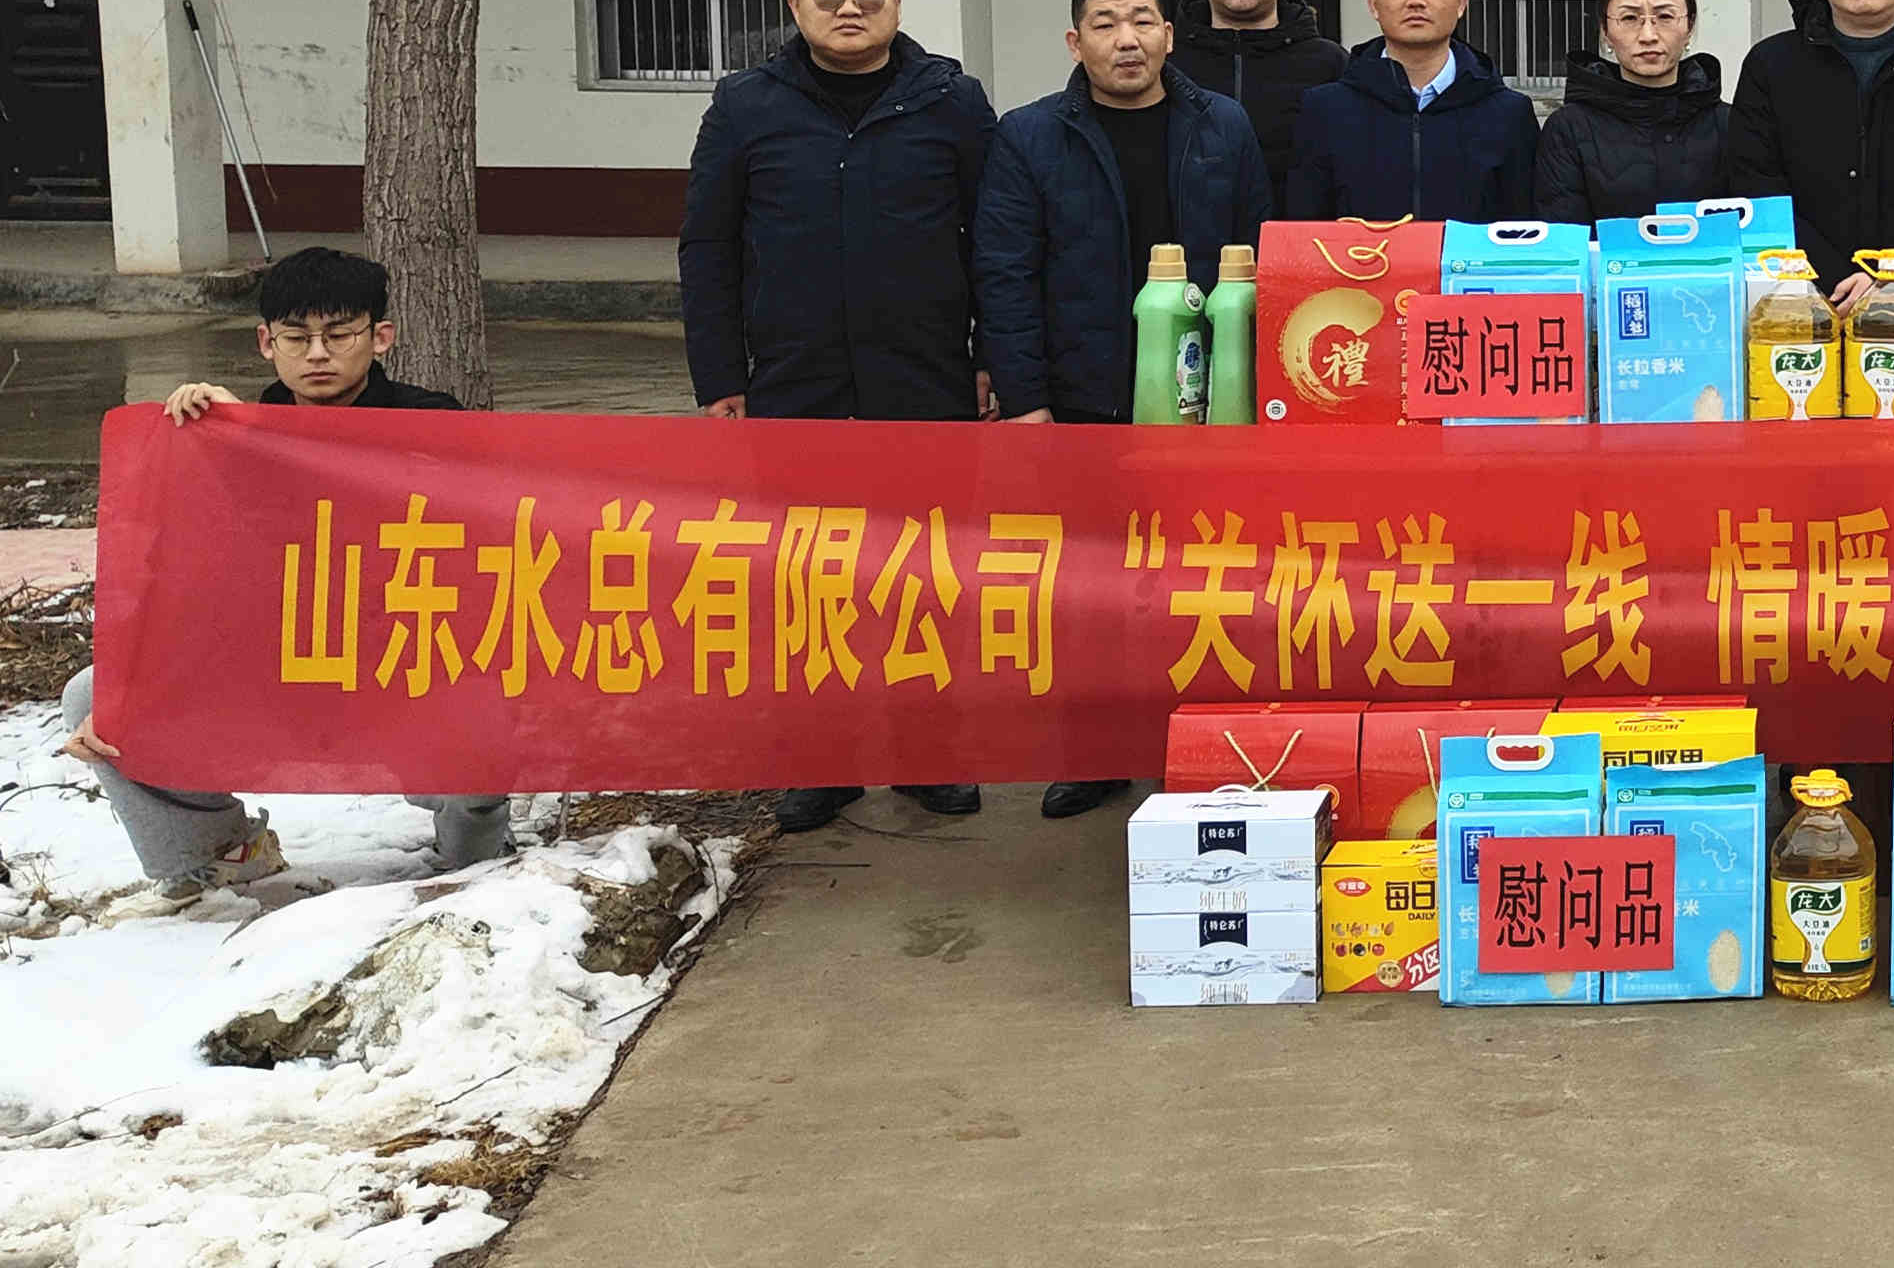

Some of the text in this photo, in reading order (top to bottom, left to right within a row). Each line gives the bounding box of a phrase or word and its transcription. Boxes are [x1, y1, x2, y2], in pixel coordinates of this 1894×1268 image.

[1321, 339, 1369, 388] 禮
[1421, 316, 1574, 396] 慰问品
[1616, 357, 1686, 376] 长粒香米
[280, 494, 1064, 698] 山东水总有限公司
[1407, 912, 1437, 921] DAILY
[1493, 859, 1664, 951] 慰问品
